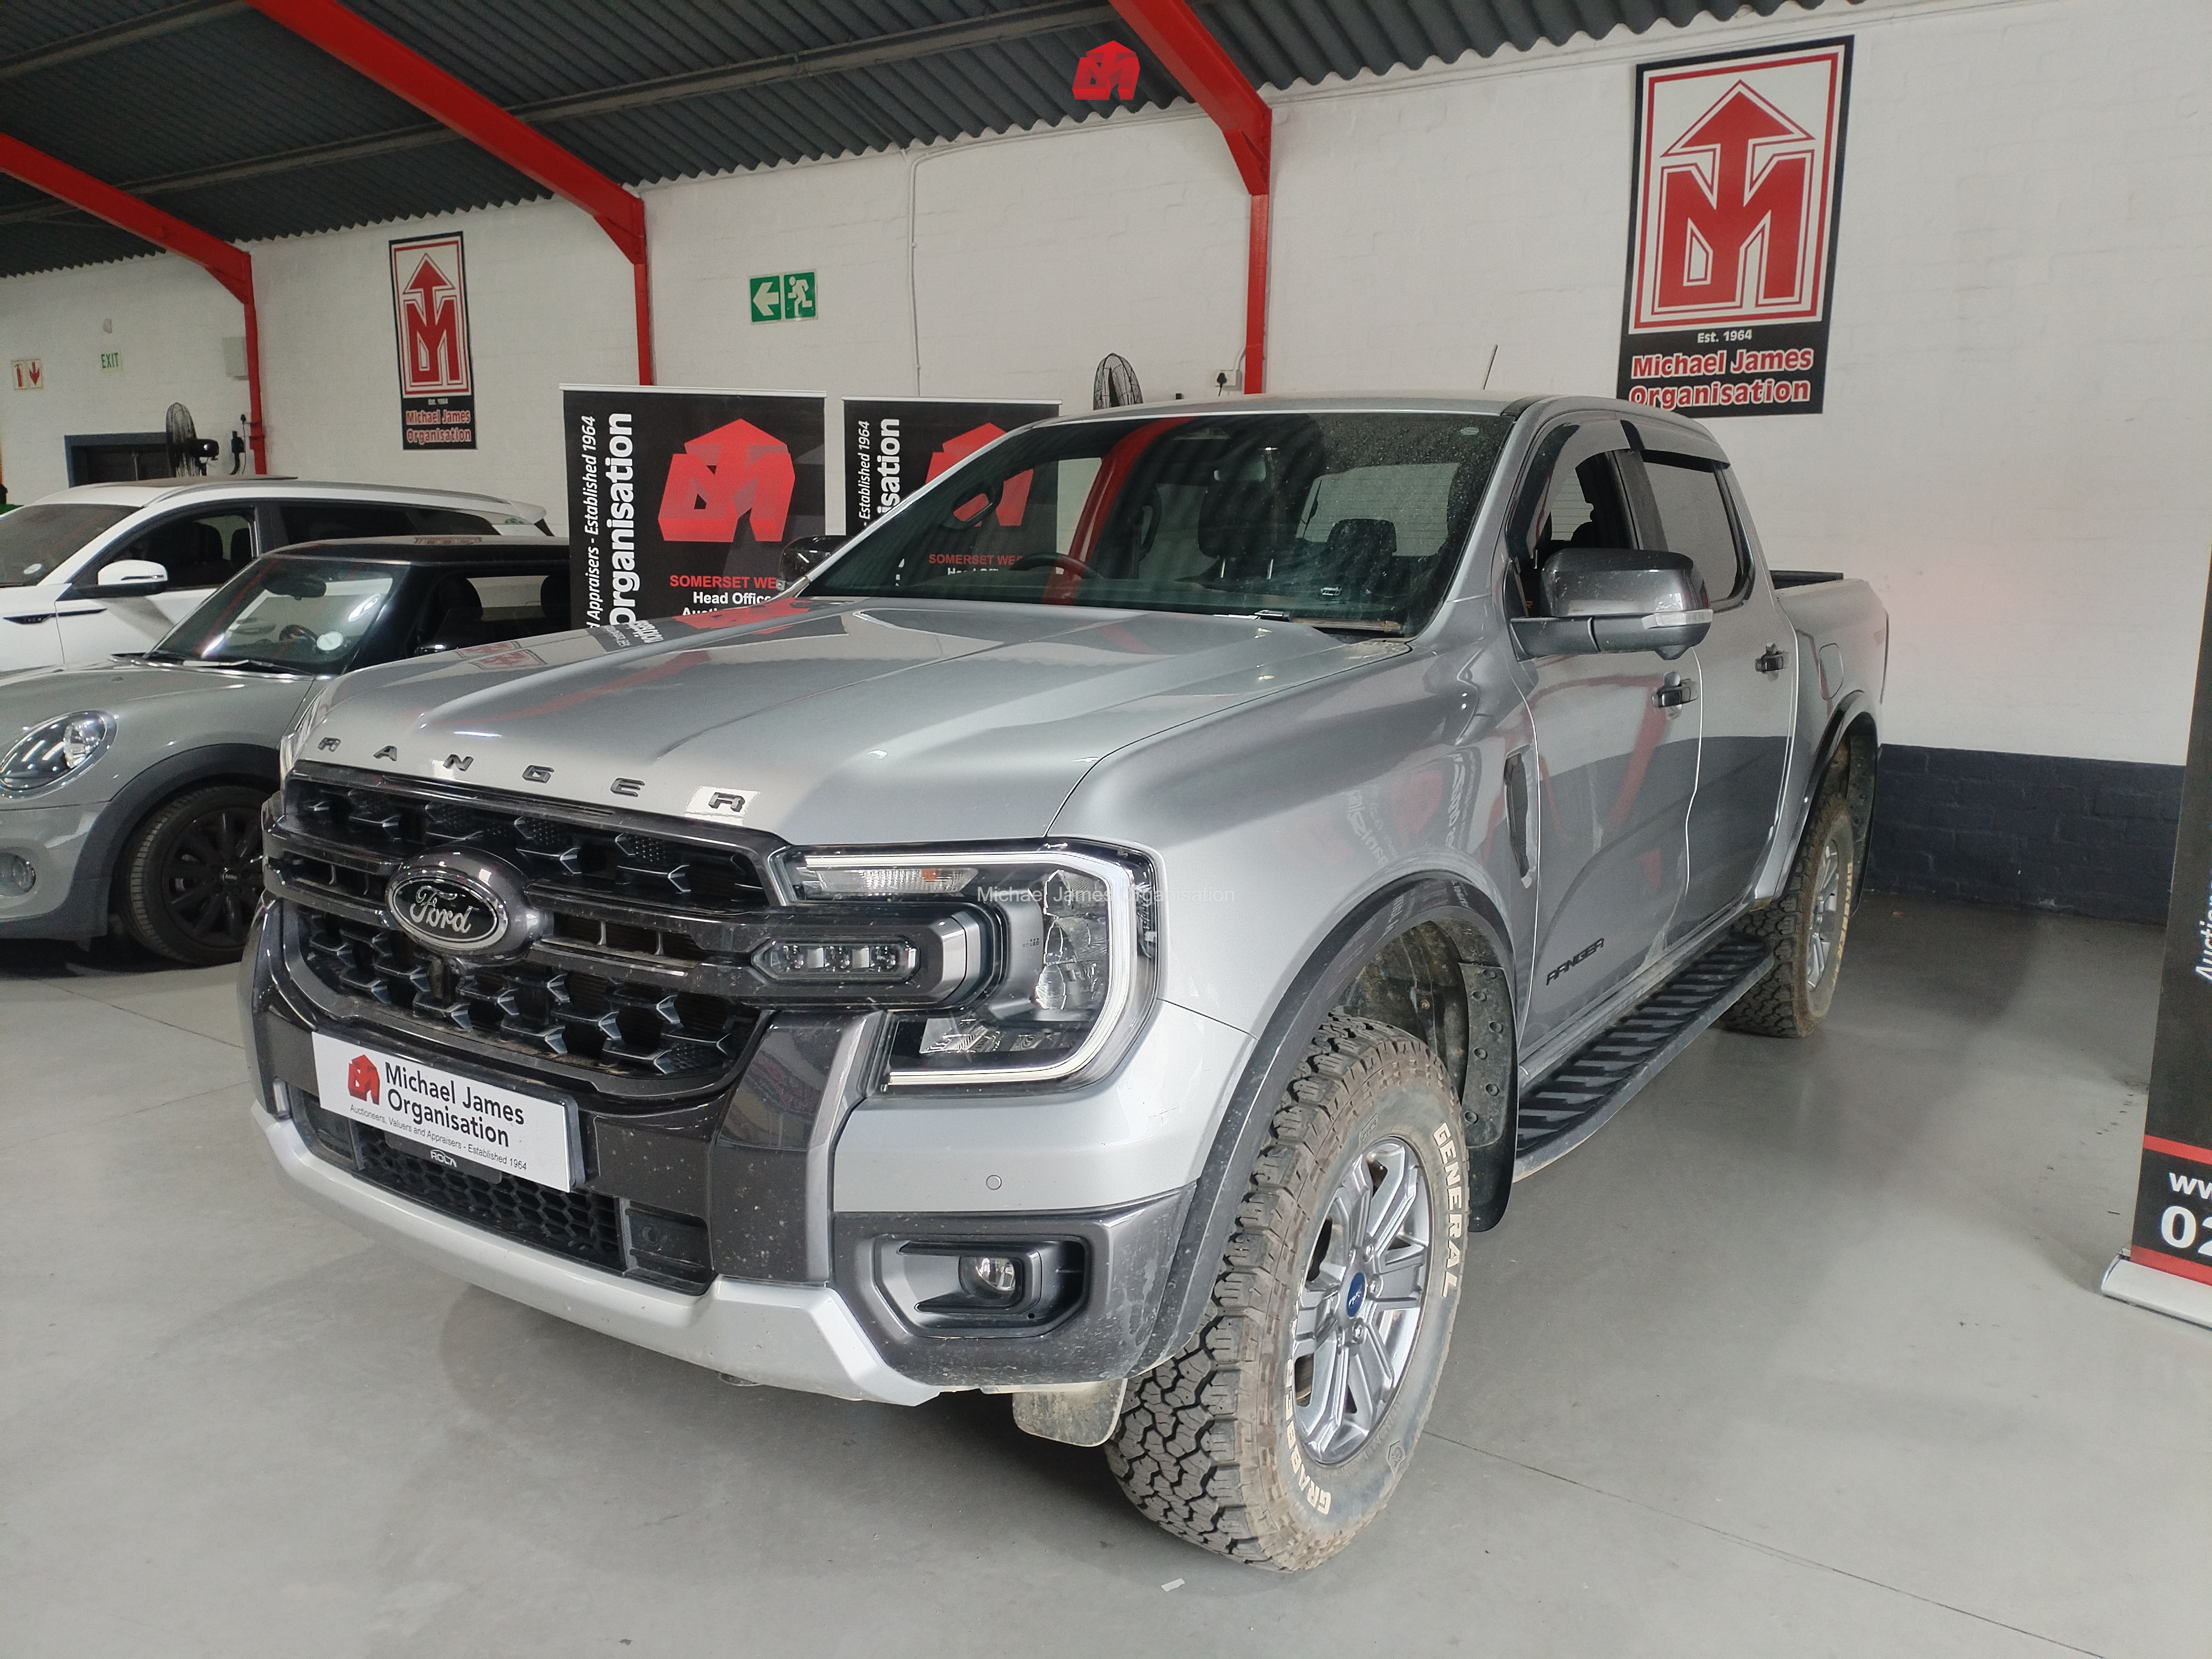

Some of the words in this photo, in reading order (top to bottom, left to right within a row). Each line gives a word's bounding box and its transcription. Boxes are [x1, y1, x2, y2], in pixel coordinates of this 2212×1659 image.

[1697, 332, 1719, 343] Est.
[1723, 329, 1752, 342] 1964
[101, 352, 118, 369] EXIT
[1631, 349, 1727, 379] Michael
[1730, 346, 1813, 374] James
[1629, 379, 1811, 412] Organisation
[406, 409, 441, 425] Michael
[442, 409, 471, 424] James
[407, 427, 472, 445] Organisation
[581, 415, 596, 451] 1964
[858, 420, 870, 450] 1964
[858, 453, 871, 520] Established
[877, 419, 900, 514] isation
[582, 454, 599, 535] Established
[928, 554, 994, 565] SOMERSET
[997, 555, 1023, 565] WE
[585, 548, 603, 621] Appraisers
[670, 575, 750, 589] SOMERSET
[753, 576, 777, 589] WE
[693, 591, 728, 604] Head
[318, 737, 745, 812] RANGER
[409, 885, 472, 933] Ford
[1546, 938, 1604, 986] RANGER
[385, 1062, 455, 1104] Michael
[462, 1087, 525, 1124] James
[350, 1104, 387, 1125] Auctioneers,
[388, 1117, 412, 1132] Valuers
[414, 1128, 425, 1136] and
[427, 1131, 462, 1150] Appraisers
[468, 1144, 507, 1164] Established
[510, 1158, 527, 1171] 1964
[388, 1089, 509, 1147] Organisation
[1433, 1122, 1462, 1298] GENERAL
